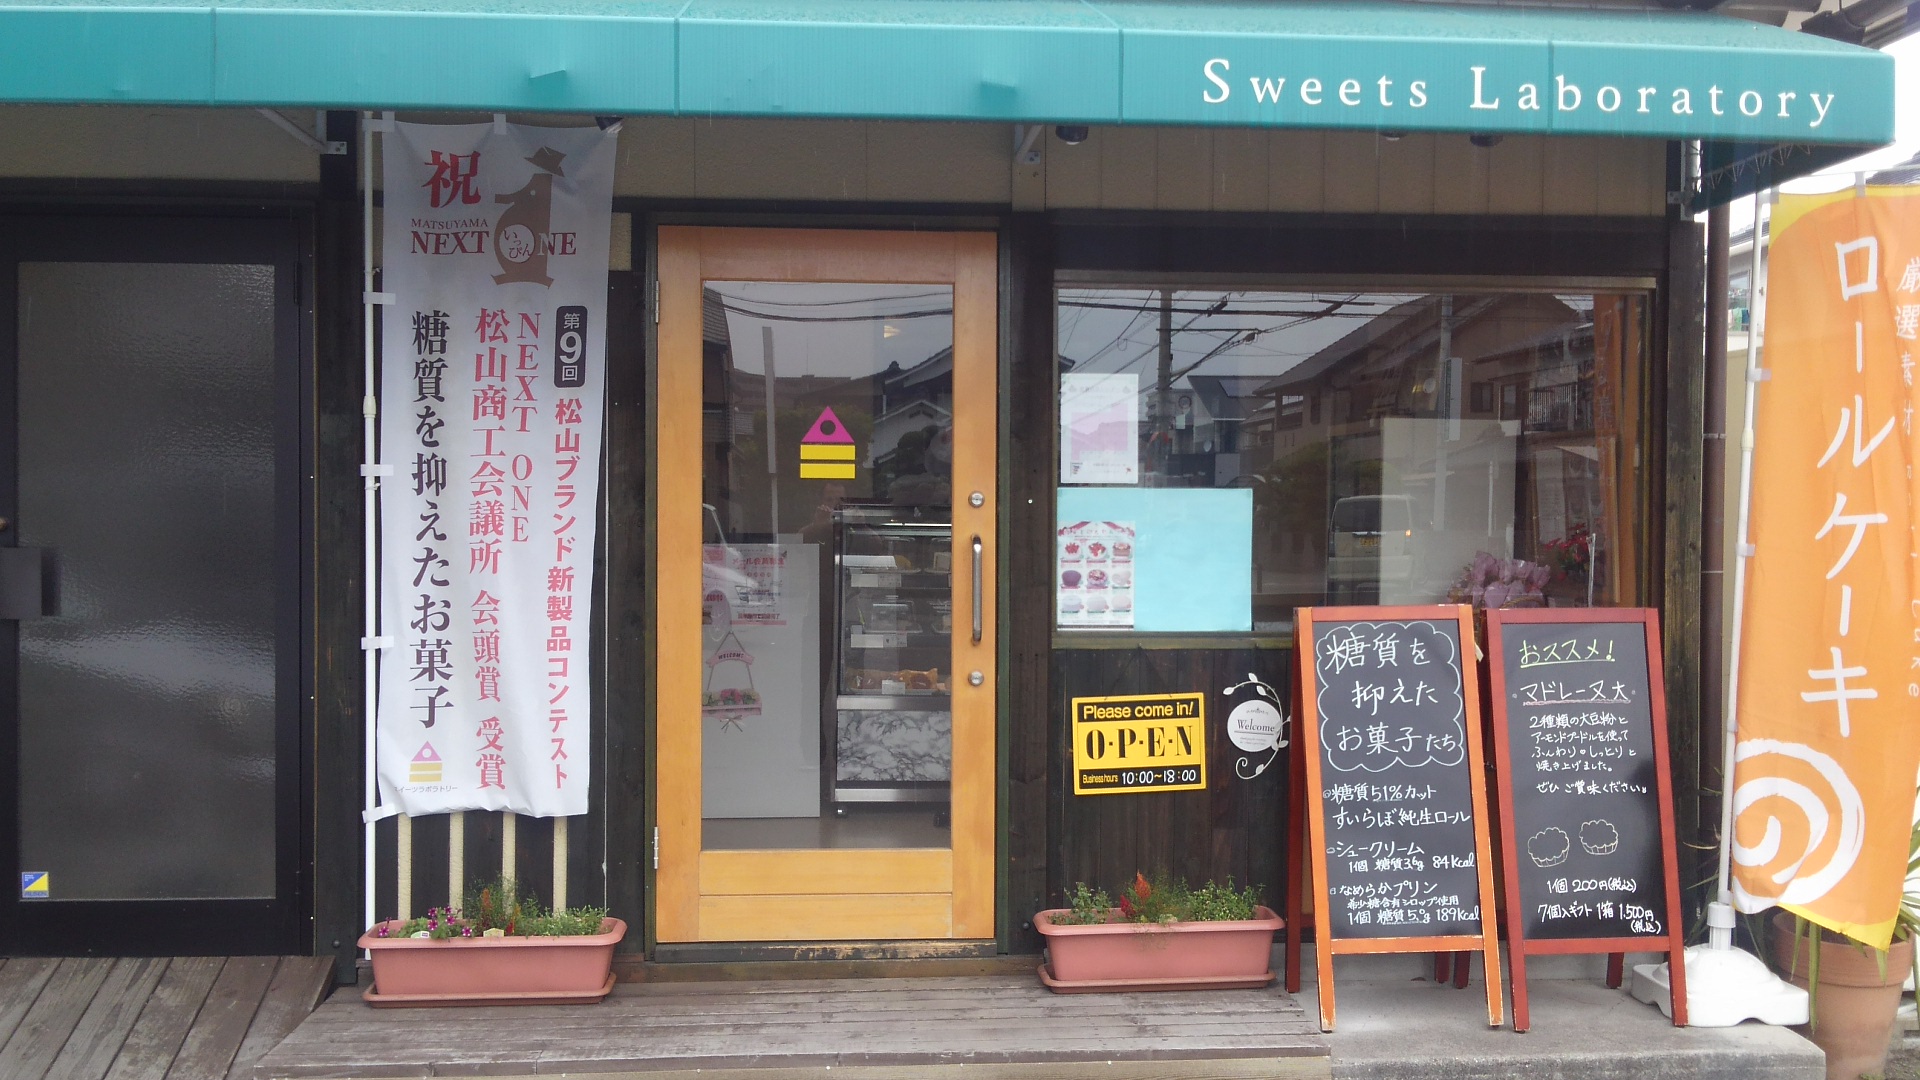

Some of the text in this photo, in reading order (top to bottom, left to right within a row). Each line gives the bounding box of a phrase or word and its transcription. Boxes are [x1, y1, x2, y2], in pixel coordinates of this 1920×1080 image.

[1202, 58, 1835, 127] Sweets Laboratory
[421, 150, 482, 208] 祝
[411, 218, 488, 230] MATSUYAMA
[410, 230, 490, 255] NEXT
[510, 312, 541, 543] NEXT ONE
[1799, 235, 1896, 739] ロールケーキ
[409, 309, 454, 729] 糖質を抑えたお菓子
[469, 307, 510, 790] 松山商工会議所 会頭賞 受賞
[546, 398, 583, 789] 松山ブランド新製品コンテスト
[1324, 631, 1431, 675] 糖質を
[1083, 701, 1194, 720] Please come in!
[1351, 678, 1438, 716] 抑えた
[1237, 718, 1275, 732] Welcome
[1336, 721, 1456, 755] お菓子たち
[1536, 780, 1559, 793] ぜひ
[1336, 841, 1425, 858] シュークリーム
[1339, 880, 1438, 897] なめらかプリン
[1546, 878, 1569, 894] 1個
